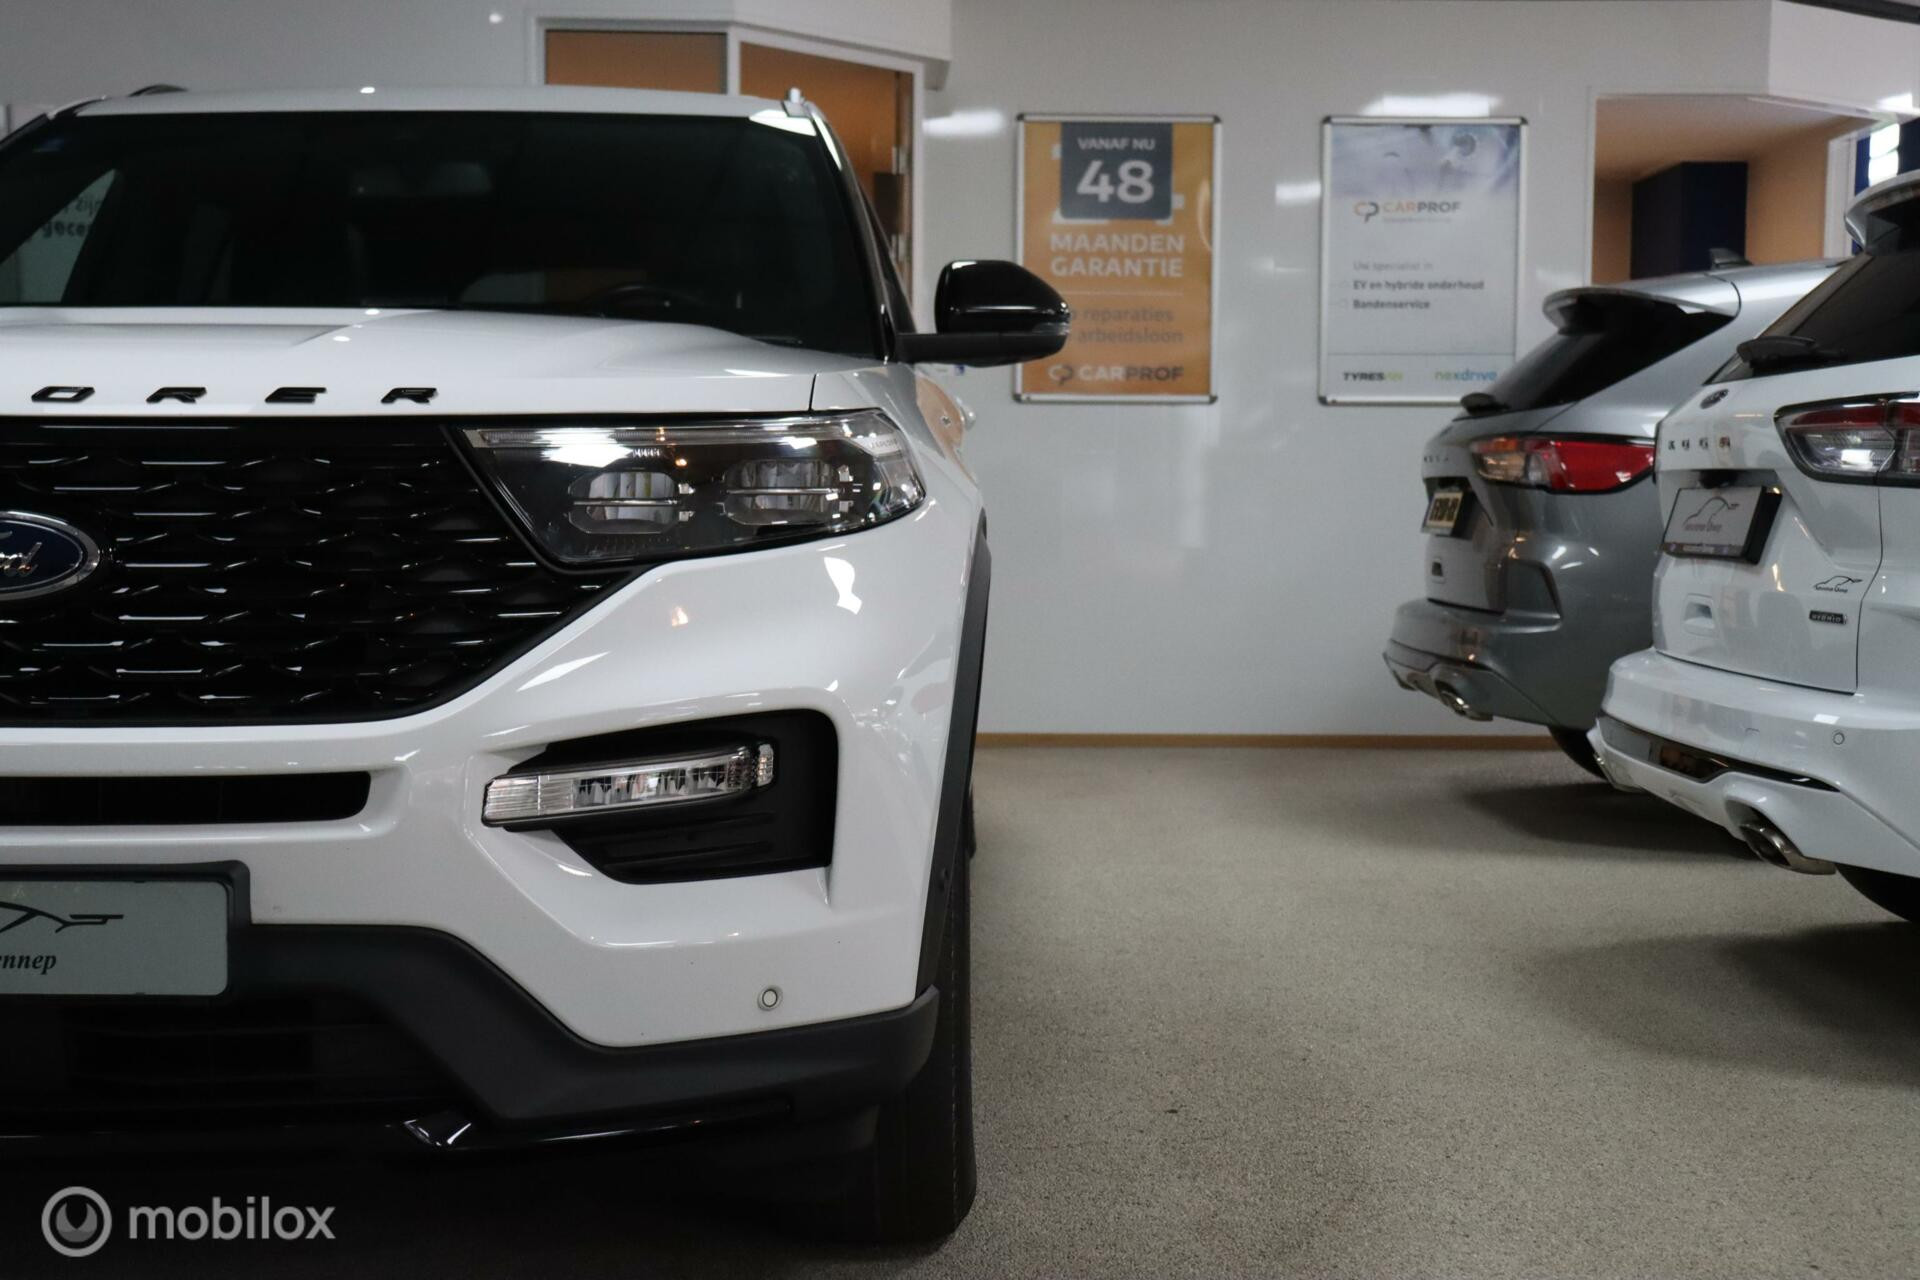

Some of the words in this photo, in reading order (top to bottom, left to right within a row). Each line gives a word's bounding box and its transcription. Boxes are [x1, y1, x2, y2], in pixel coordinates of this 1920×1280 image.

[1077, 138, 1131, 150] VANAF
[1132, 139, 1155, 150] NU
[1076, 160, 1154, 203] 48
[1383, 202, 1461, 213] CARPROF
[1050, 234, 1184, 253] MAANDEN
[1051, 257, 1183, 277] GARANTIE
[1353, 299, 1430, 309] Bandenservice
[1083, 308, 1174, 322] reparaties
[1079, 329, 1184, 344] arbeidsloon
[1079, 364, 1184, 381] CARPROF
[0, 953, 57, 975] nnep
